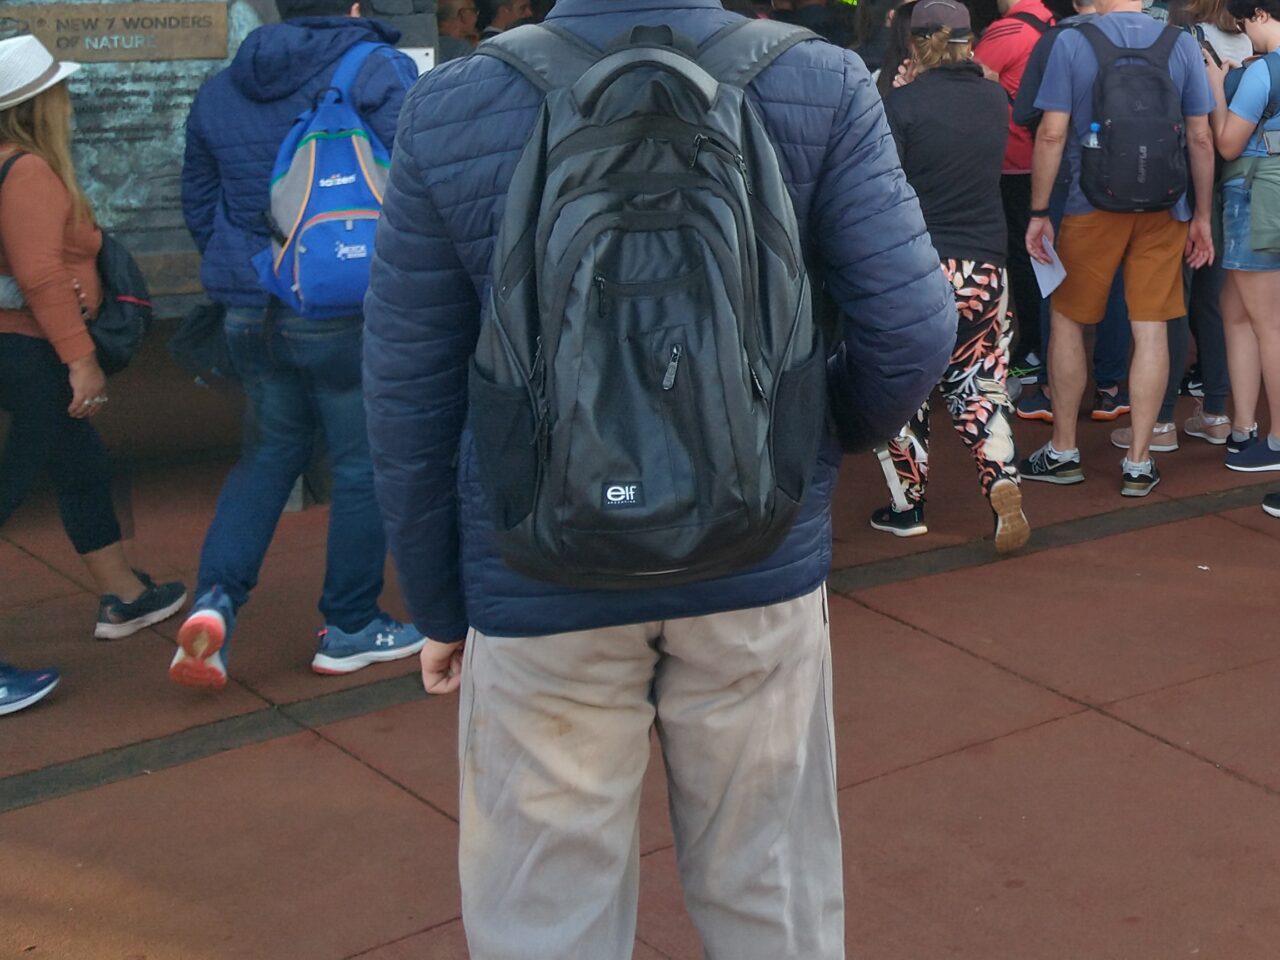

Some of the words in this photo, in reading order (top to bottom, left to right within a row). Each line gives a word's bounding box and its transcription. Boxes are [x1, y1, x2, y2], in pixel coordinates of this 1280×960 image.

[56, 17, 99, 32] NEW
[105, 17, 116, 30] 7
[121, 15, 213, 29] WONDERS
[56, 36, 78, 51] OF
[606, 485, 637, 501] elf
